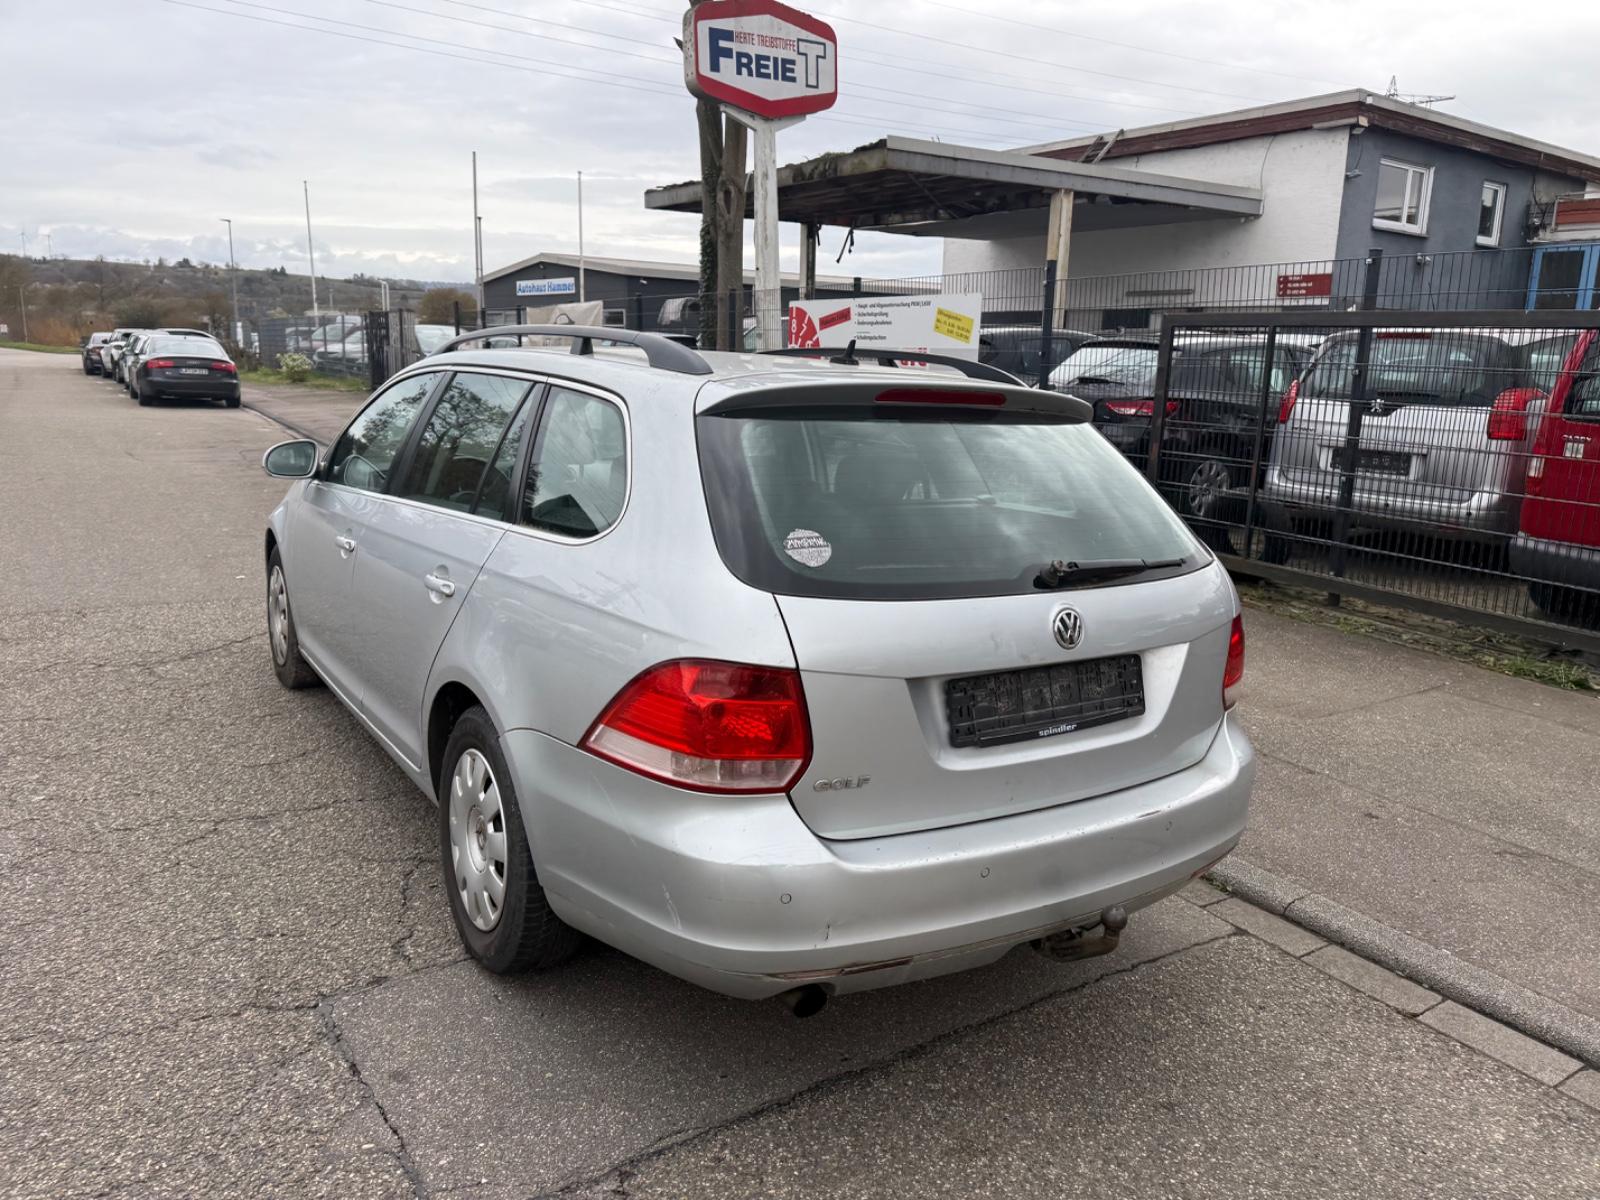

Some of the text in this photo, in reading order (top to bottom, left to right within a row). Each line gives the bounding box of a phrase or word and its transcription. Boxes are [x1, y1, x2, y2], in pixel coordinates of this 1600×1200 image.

[708, 27, 797, 83] FREIE
[1038, 723, 1077, 737] spindler
[813, 775, 871, 793] GOLF
